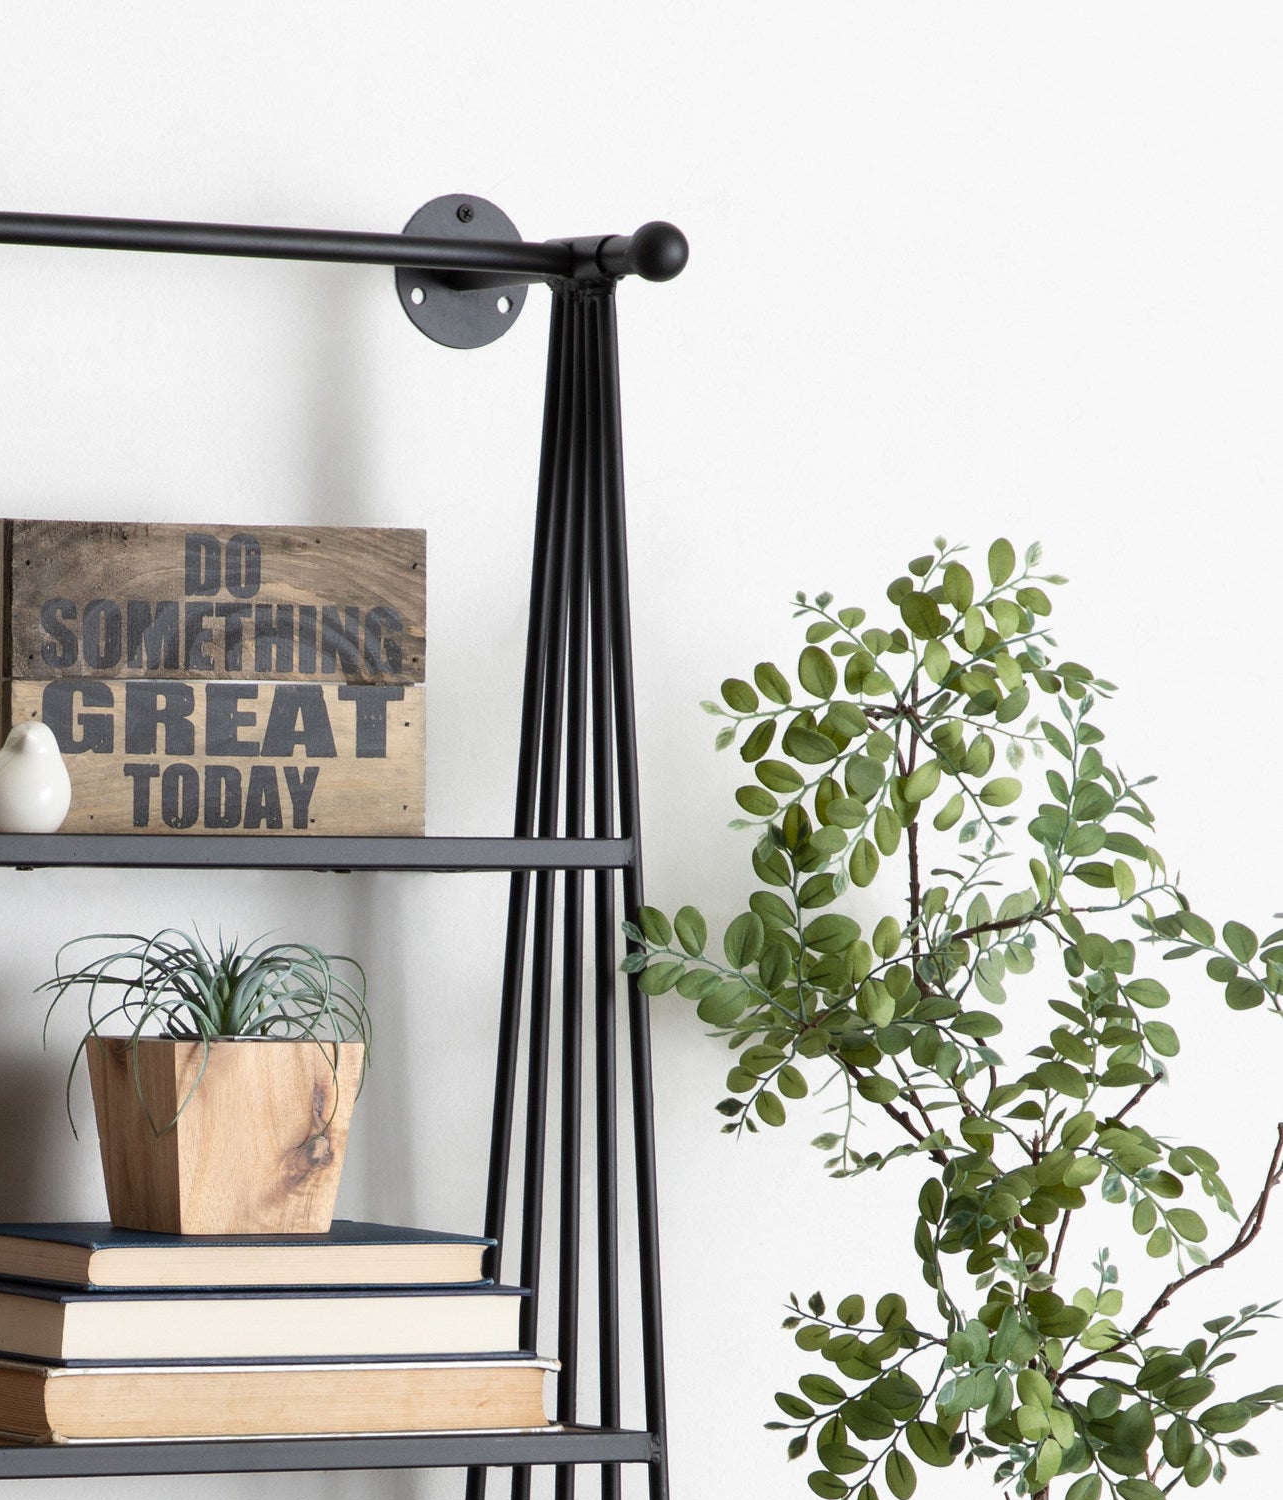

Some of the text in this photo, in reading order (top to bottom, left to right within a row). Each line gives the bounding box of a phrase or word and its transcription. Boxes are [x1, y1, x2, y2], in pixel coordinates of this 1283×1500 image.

[184, 533, 262, 598] DO
[40, 599, 404, 675] SOMETHING
[41, 680, 405, 759] GREAT
[123, 763, 320, 830] TODAY
